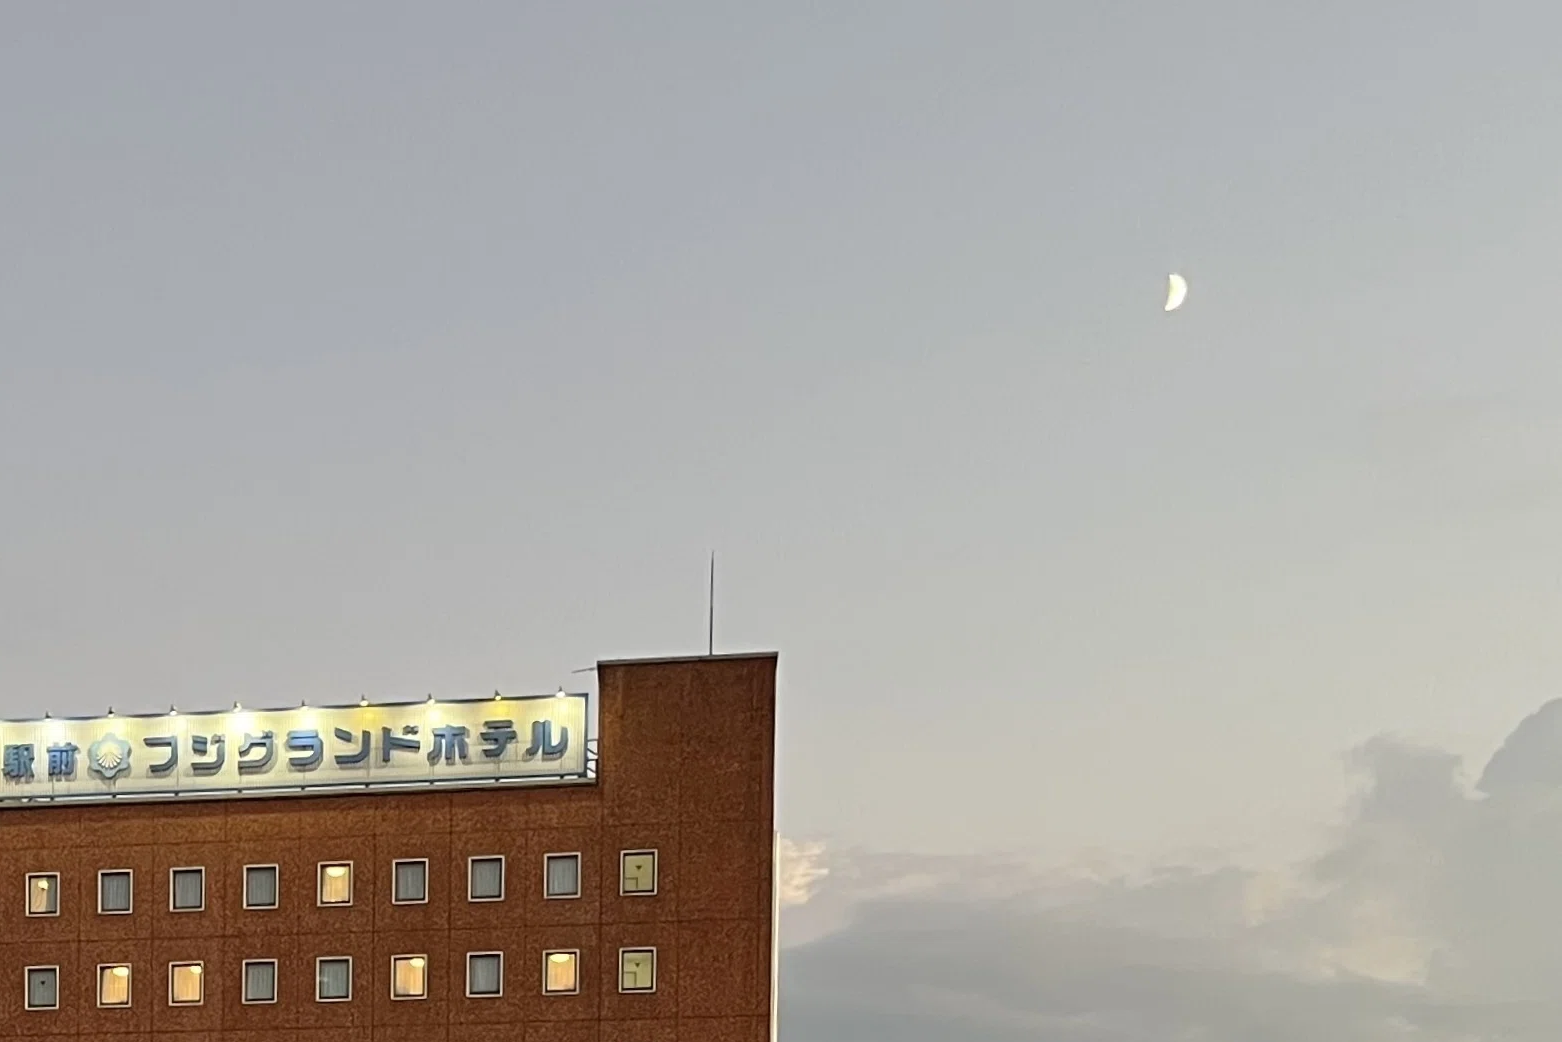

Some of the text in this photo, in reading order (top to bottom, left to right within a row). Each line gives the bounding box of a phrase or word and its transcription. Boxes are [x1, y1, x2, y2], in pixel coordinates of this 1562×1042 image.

[1, 719, 571, 779] 駅前 フジグランドホテル
